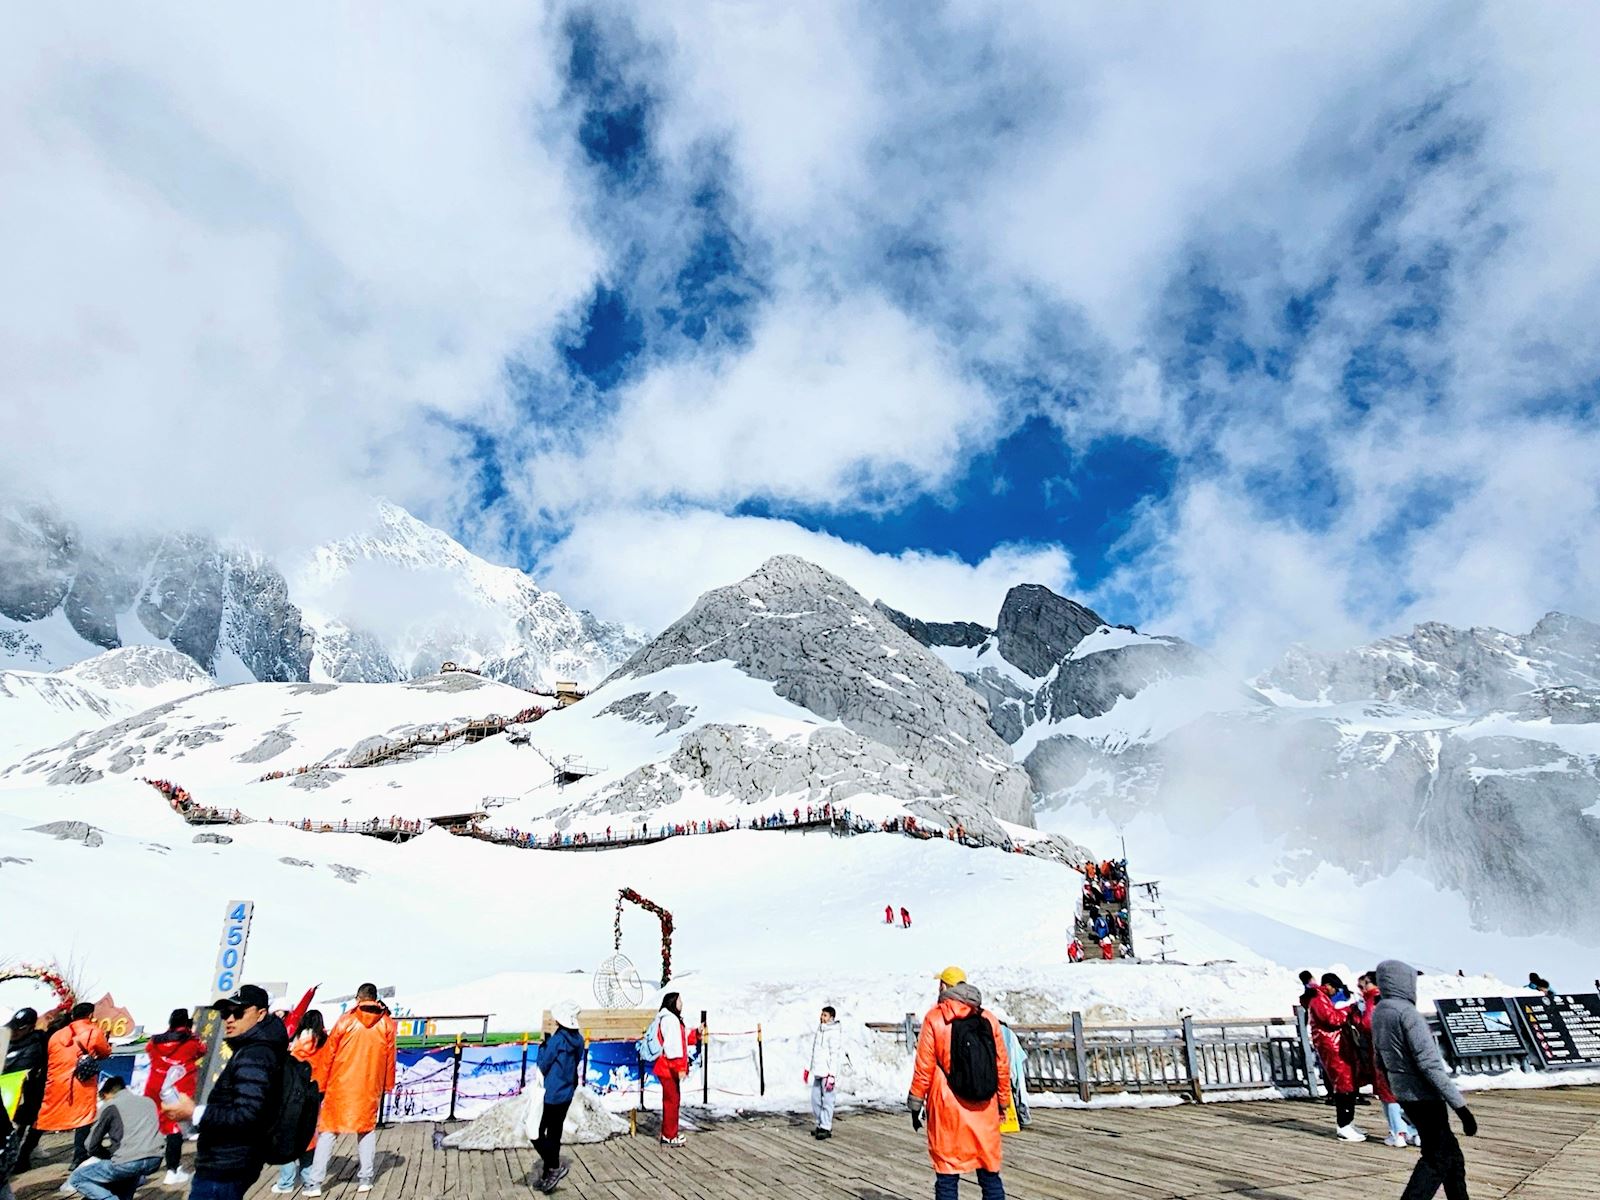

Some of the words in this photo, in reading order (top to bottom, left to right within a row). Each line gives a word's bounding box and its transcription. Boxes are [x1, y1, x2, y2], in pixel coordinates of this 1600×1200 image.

[217, 903, 246, 992] 4506
[91, 1015, 128, 1037] 06
[393, 1018, 438, 1036] 506
